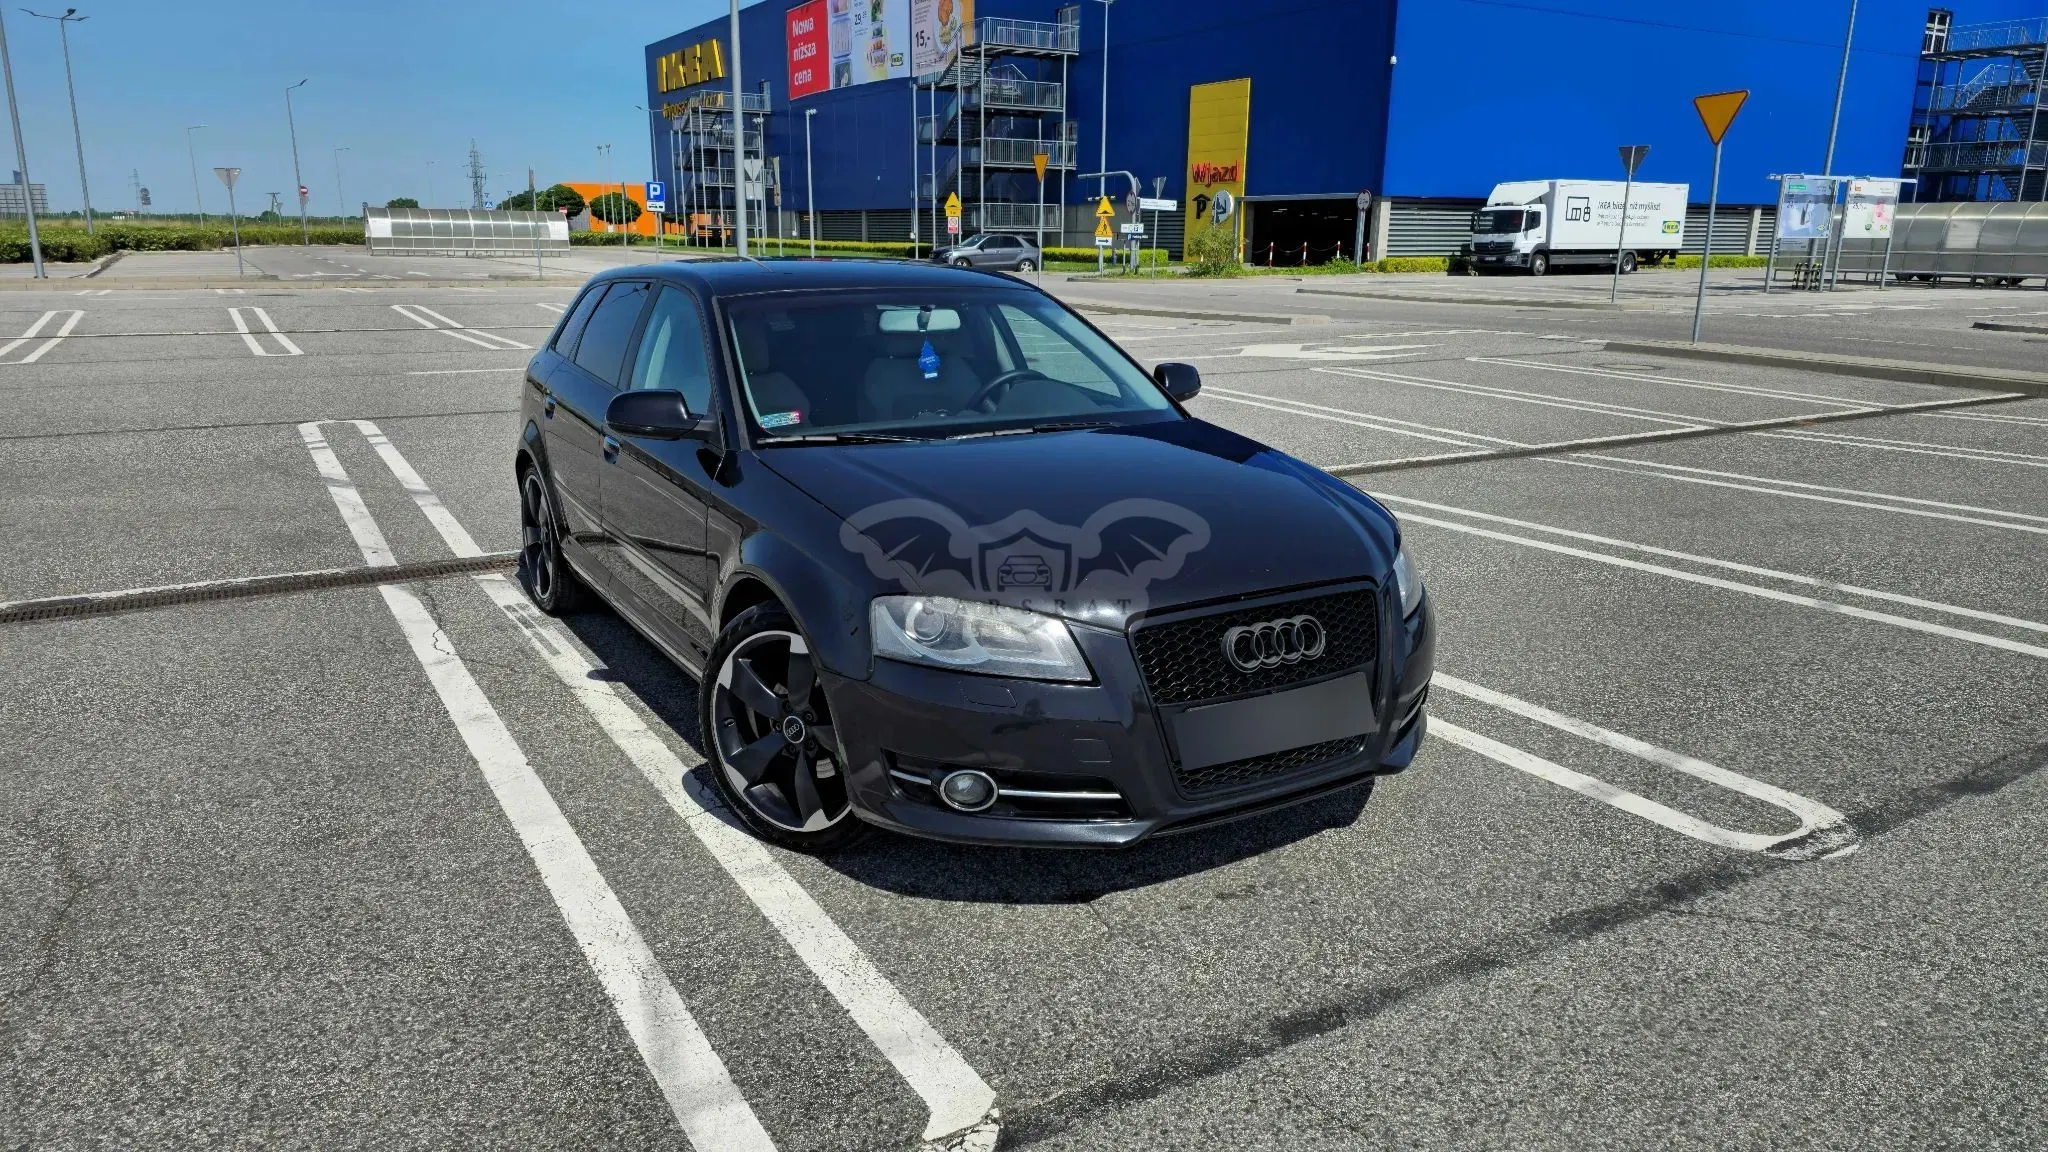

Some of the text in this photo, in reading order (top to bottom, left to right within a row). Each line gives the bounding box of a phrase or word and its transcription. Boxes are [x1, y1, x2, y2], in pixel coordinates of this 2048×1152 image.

[792, 16, 815, 37] Nowa
[915, 30, 931, 48] 15,-
[793, 42, 817, 61] niższa
[656, 38, 725, 93] IKEA
[794, 69, 812, 85] cena
[1191, 160, 1240, 188] Wjazd
[649, 183, 661, 199] P
[1597, 201, 1611, 210] IKEA
[1664, 223, 1679, 231] IKEA
